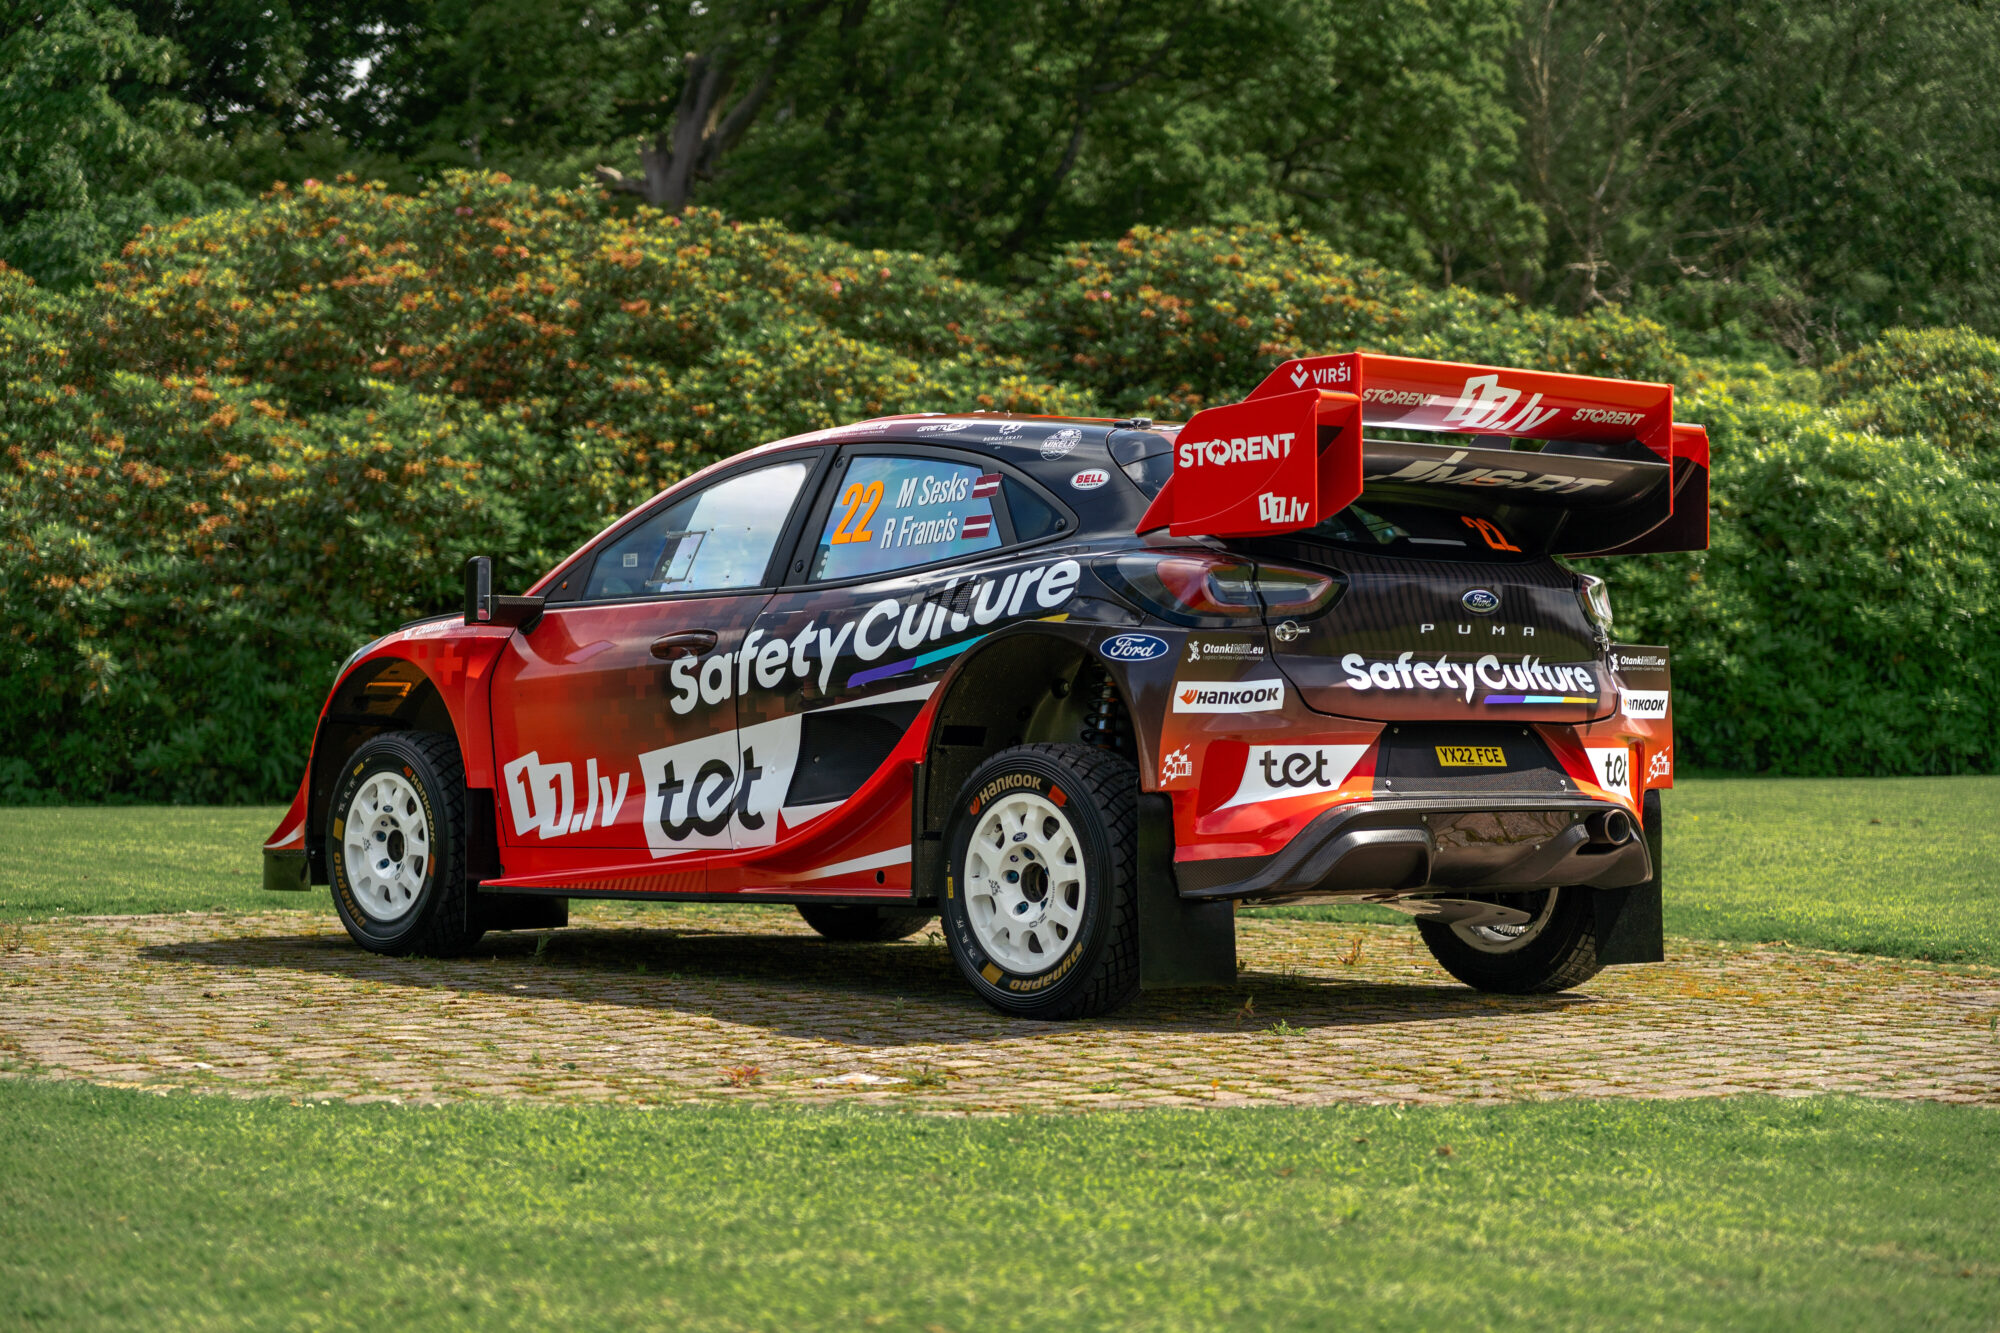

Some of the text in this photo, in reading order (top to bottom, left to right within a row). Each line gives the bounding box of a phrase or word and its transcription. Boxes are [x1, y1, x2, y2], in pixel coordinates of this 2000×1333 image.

[1312, 362, 1351, 384] VIRŠI
[1361, 388, 1440, 407] STORENT
[1443, 374, 1560, 432] 11.lv
[1571, 408, 1646, 426] STORENT
[1179, 432, 1295, 468] STORENT
[896, 472, 969, 509] M Sesks
[1076, 474, 1104, 483] BELL
[831, 480, 884, 545] 22
[1258, 492, 1309, 523] 11.lv
[880, 511, 958, 549] R Francis
[1460, 515, 1522, 552] 22
[670, 560, 1081, 715] SafetyCulture
[1421, 624, 1535, 637] PUMA
[1341, 651, 1596, 704] SafetyCulture
[1259, 749, 1332, 788] tet
[1440, 748, 1502, 763] YX22 FCE
[503, 750, 630, 840] 11.lv
[657, 746, 765, 841] tet
